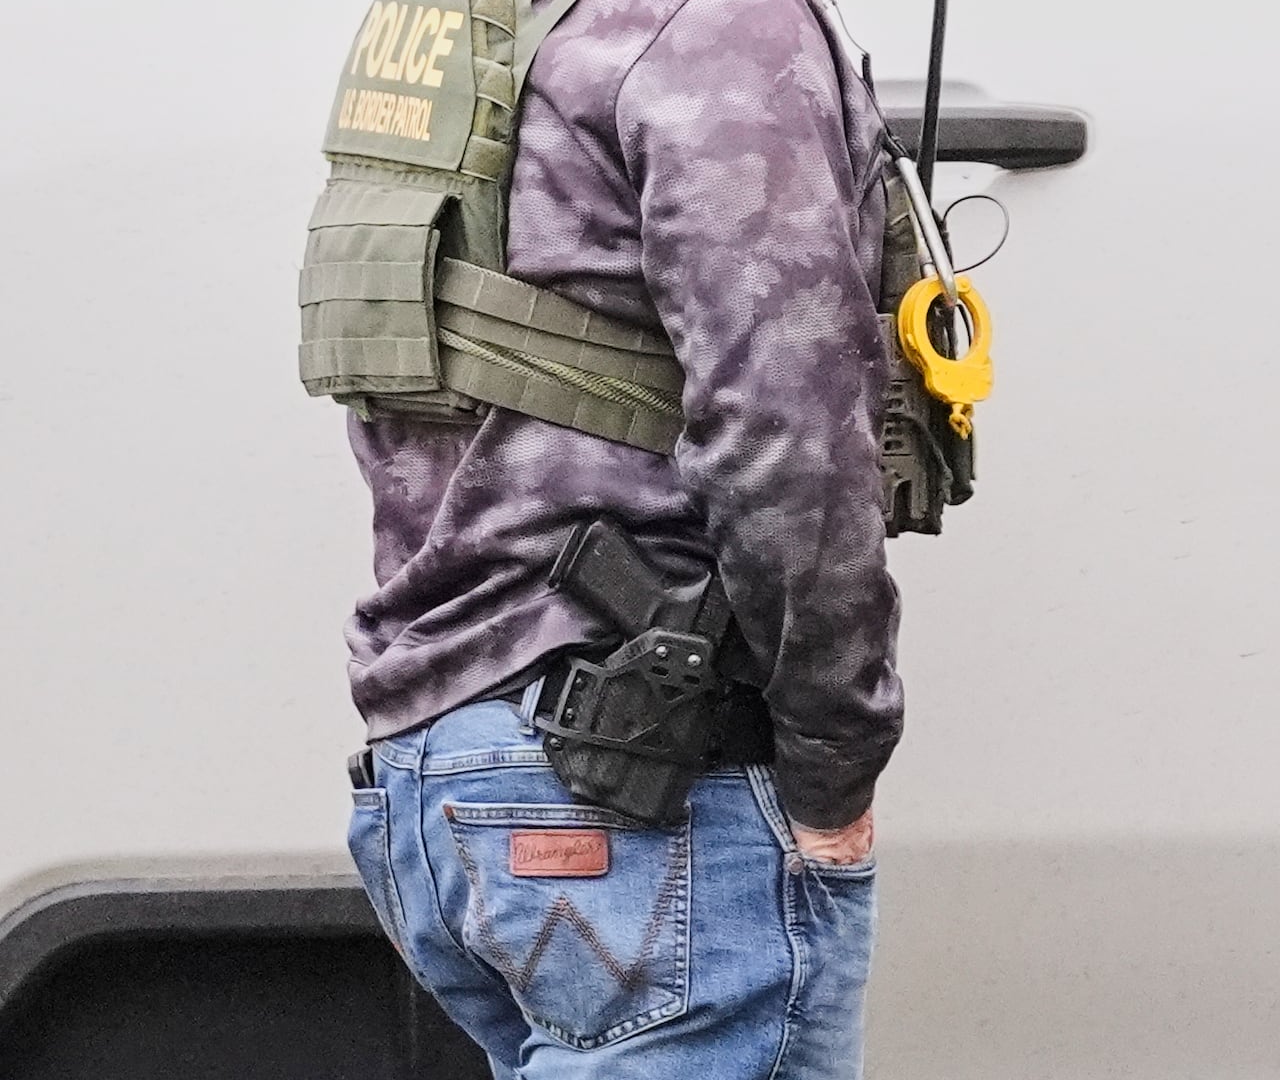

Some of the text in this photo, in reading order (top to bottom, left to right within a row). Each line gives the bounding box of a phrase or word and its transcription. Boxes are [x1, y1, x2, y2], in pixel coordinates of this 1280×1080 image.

[351, 0, 464, 87] POLICE
[351, 89, 397, 135] BORDER
[390, 95, 433, 141] PATROL
